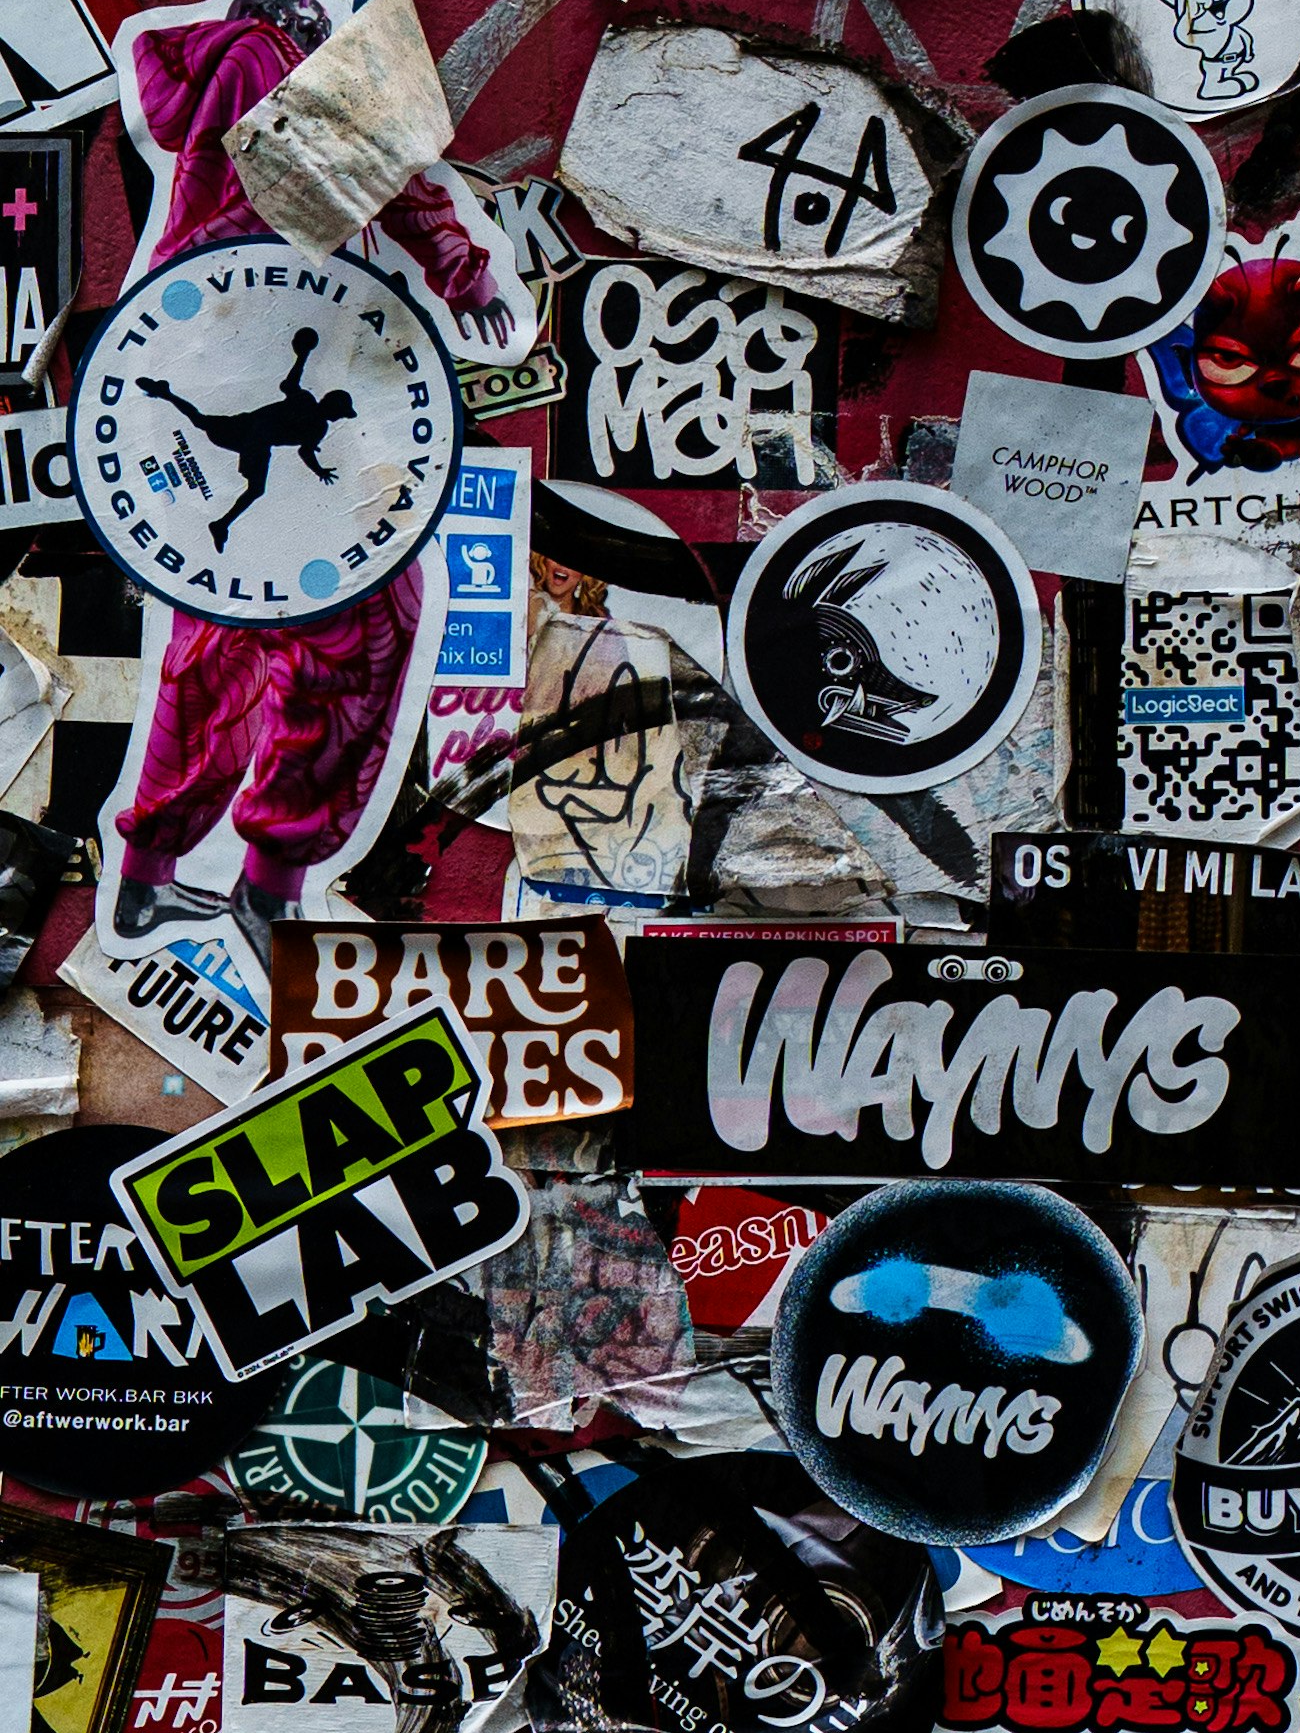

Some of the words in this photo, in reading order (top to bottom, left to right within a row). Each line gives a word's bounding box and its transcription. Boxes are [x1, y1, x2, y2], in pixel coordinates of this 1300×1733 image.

[206, 264, 350, 305] VIENI
[116, 311, 155, 353] IL
[359, 309, 388, 338] A
[340, 346, 434, 572] PROVARE
[992, 445, 1110, 484] CAMPHOR
[97, 375, 290, 605] DODGEBALL
[1131, 692, 1242, 718] LogicBeat
[1185, 850, 1235, 897] MI
[311, 930, 590, 1026] BARE
[156, 1036, 473, 1260] SLAP
[206, 1139, 501, 1335] LAB
[173, 1386, 214, 1405] BKK
[1191, 1307, 1254, 1441] SUPPORT
[1235, 1563, 1289, 1609] AND
